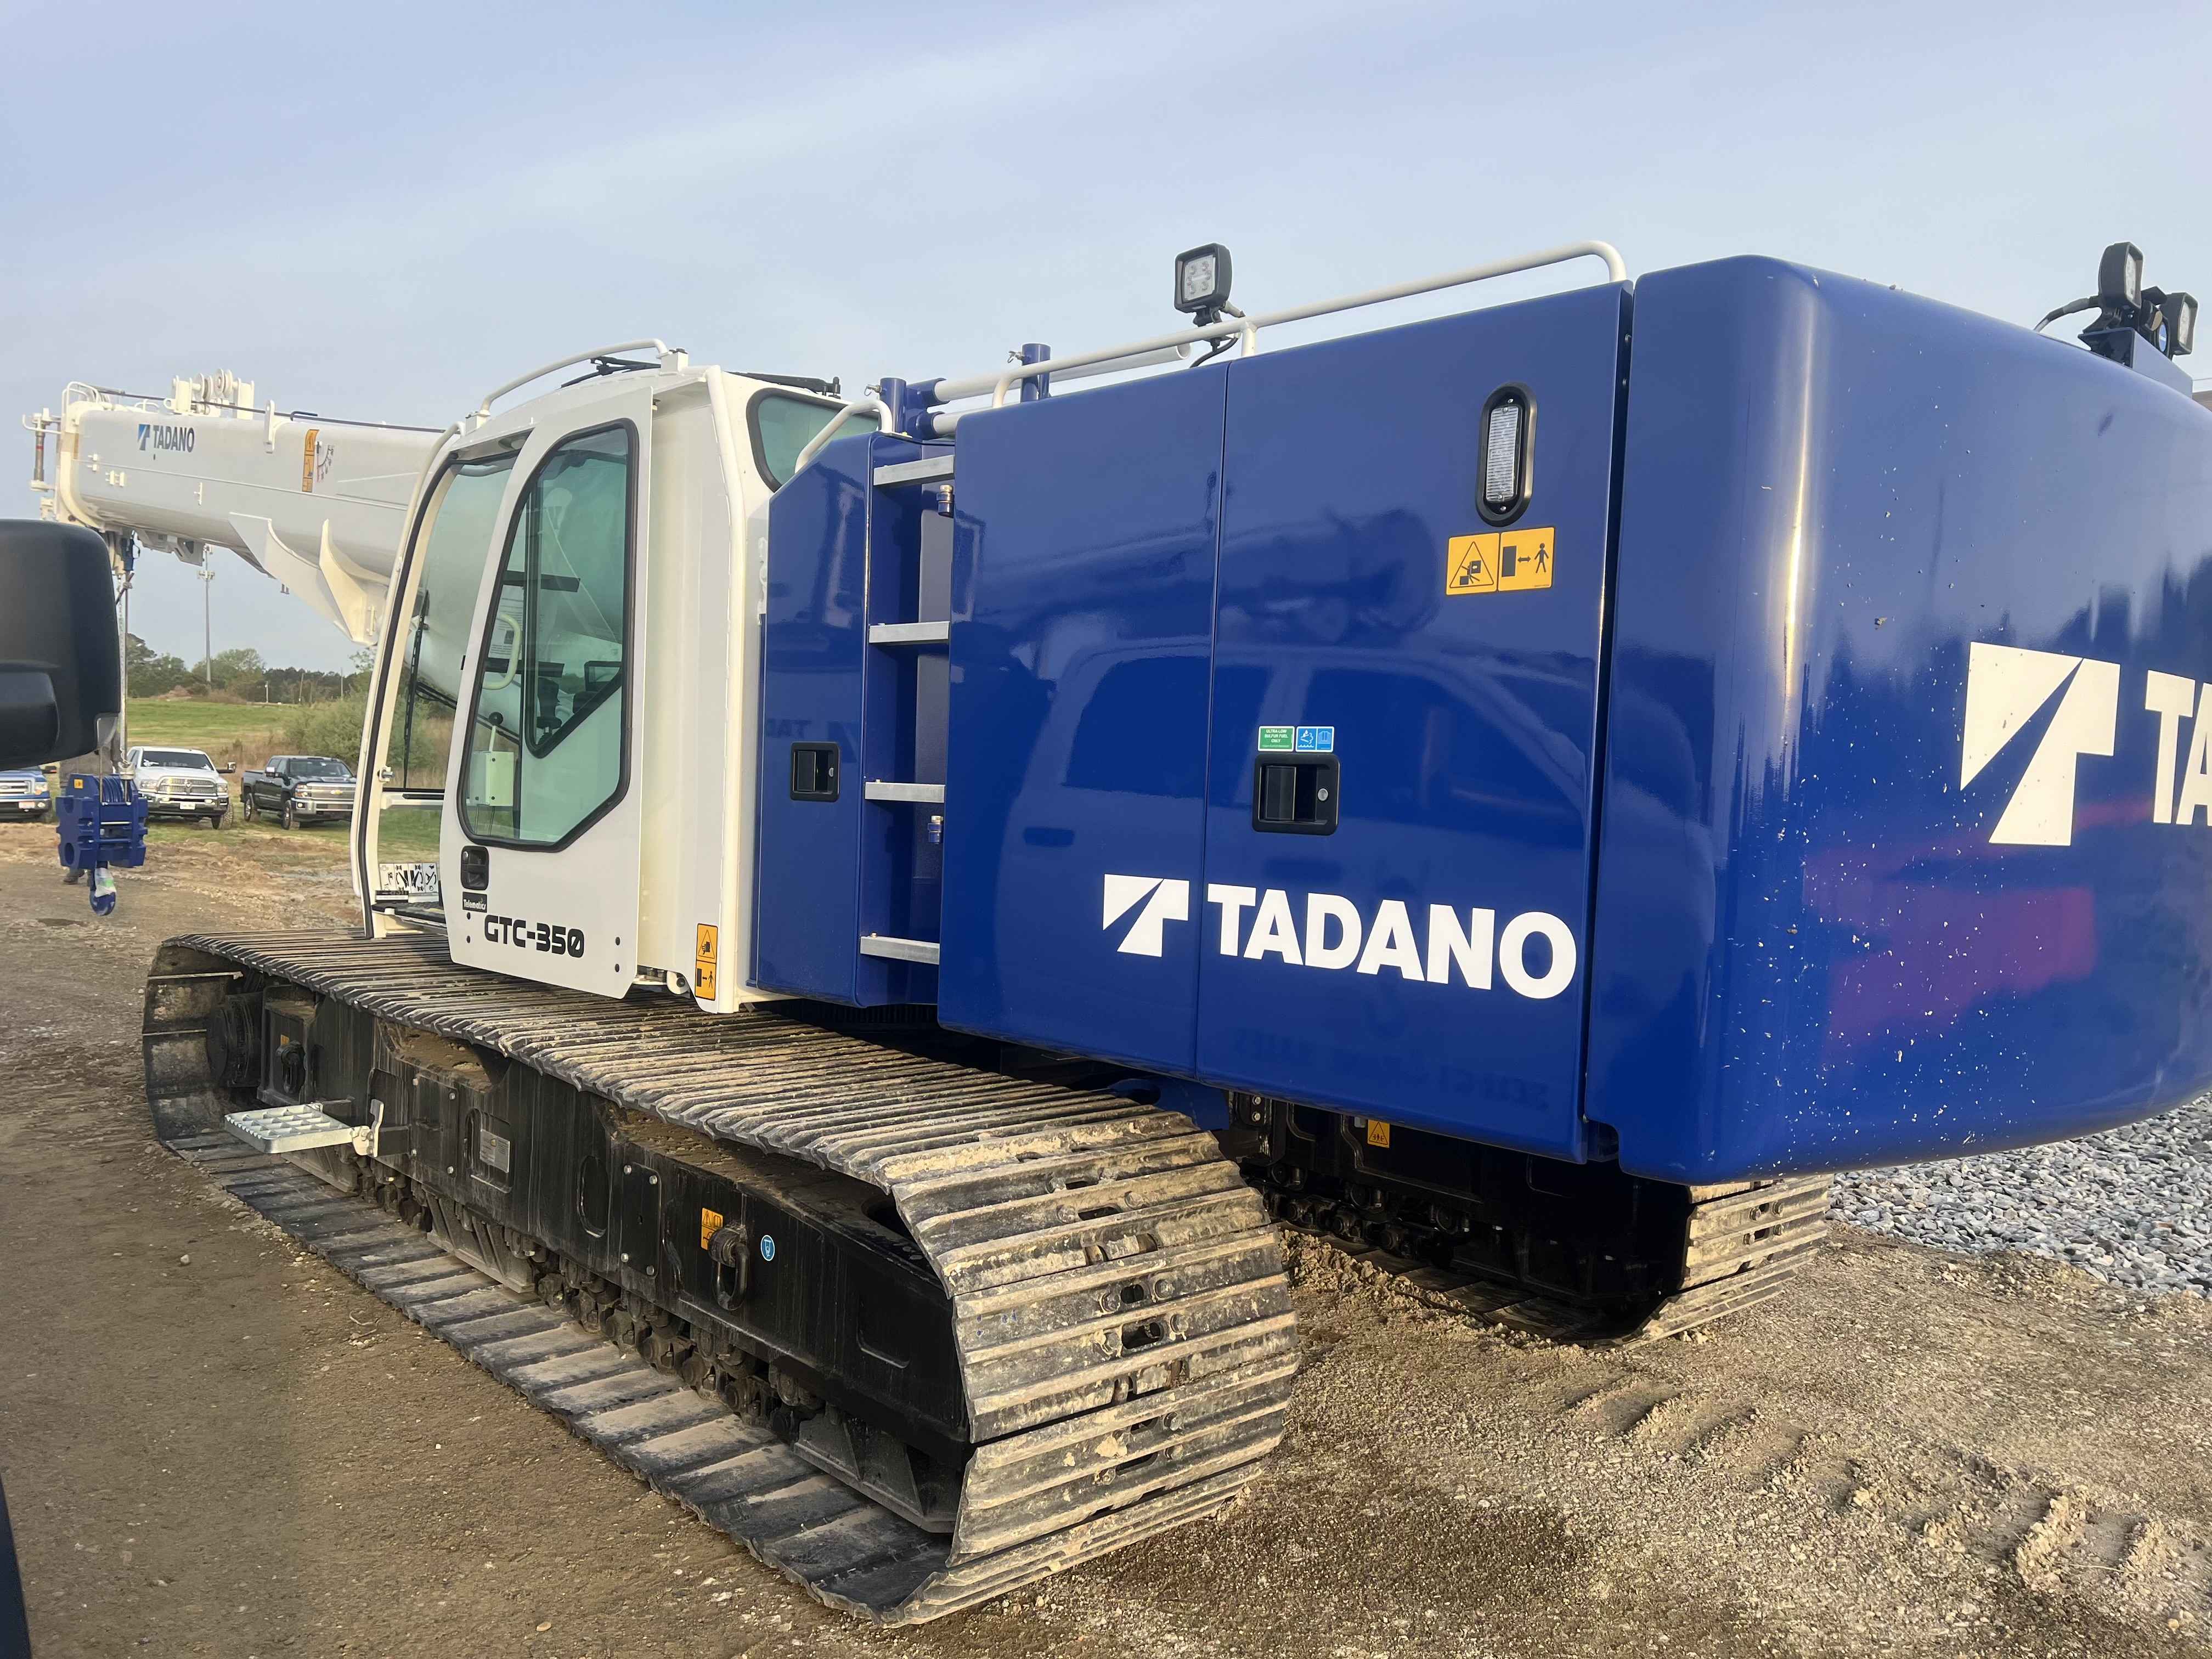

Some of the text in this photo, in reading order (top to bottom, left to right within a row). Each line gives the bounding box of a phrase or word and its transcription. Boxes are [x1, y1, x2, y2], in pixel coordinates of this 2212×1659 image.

[153, 425, 194, 453] TADANO
[463, 898, 487, 911] Telematics
[484, 915, 584, 958] GTC-350
[1208, 884, 1576, 998] TADANO
